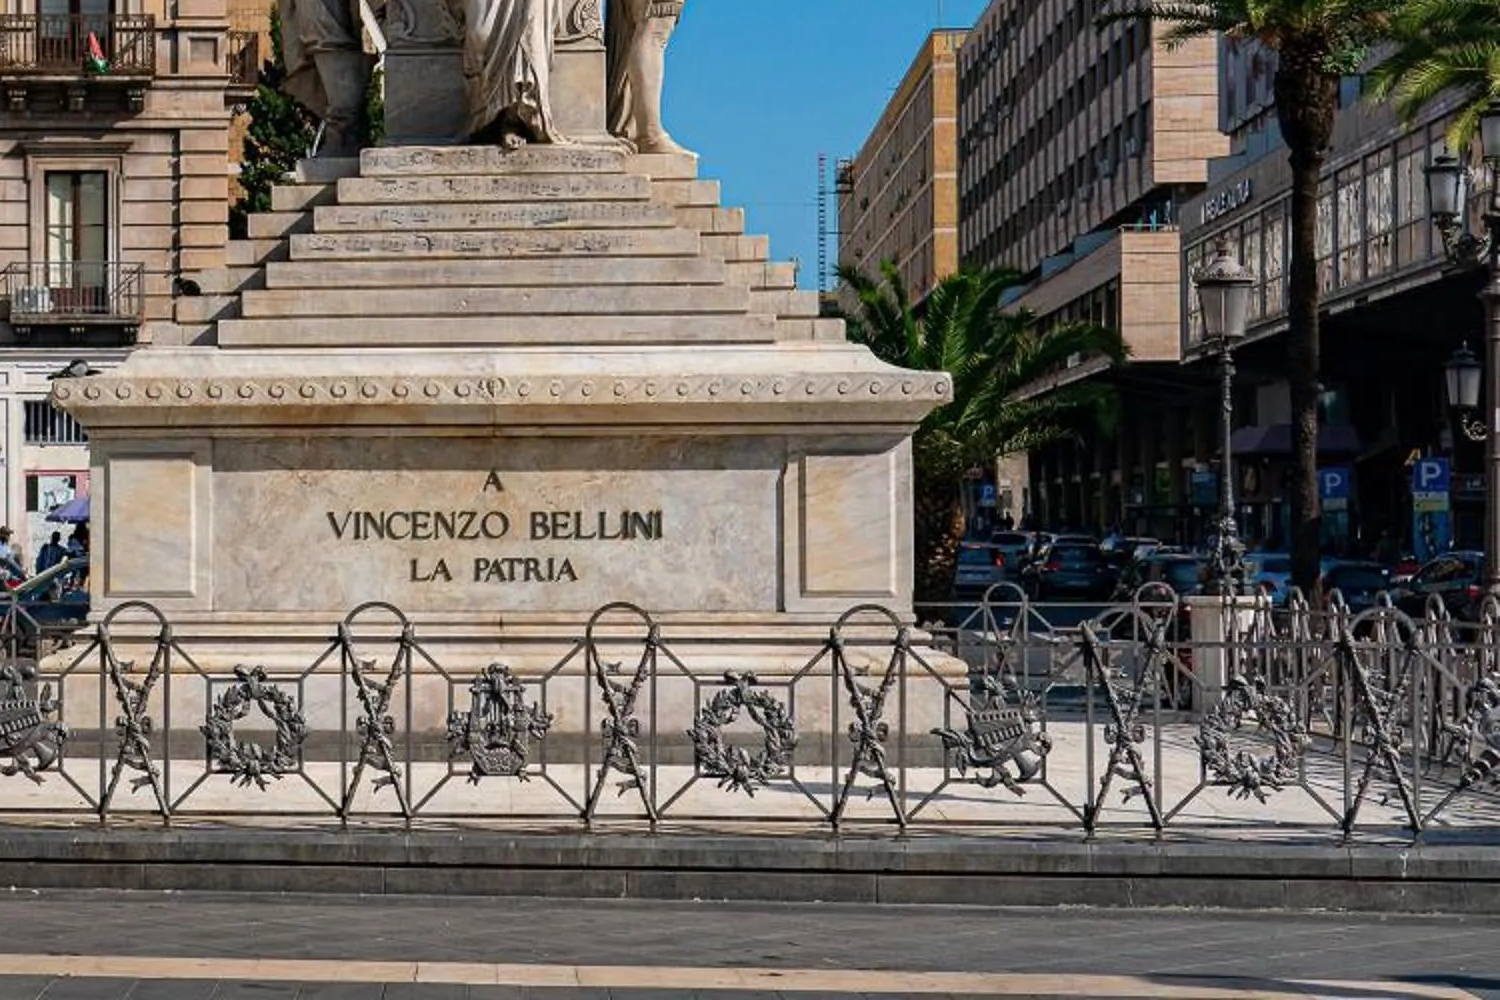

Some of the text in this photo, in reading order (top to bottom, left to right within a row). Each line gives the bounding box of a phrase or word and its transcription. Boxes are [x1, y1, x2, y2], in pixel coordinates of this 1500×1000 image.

[483, 469, 504, 492] A
[1324, 472, 1342, 495] P
[1421, 461, 1442, 488] P
[327, 509, 663, 541] VINCENZO BELLINI
[409, 556, 579, 583] LA PATRIA
